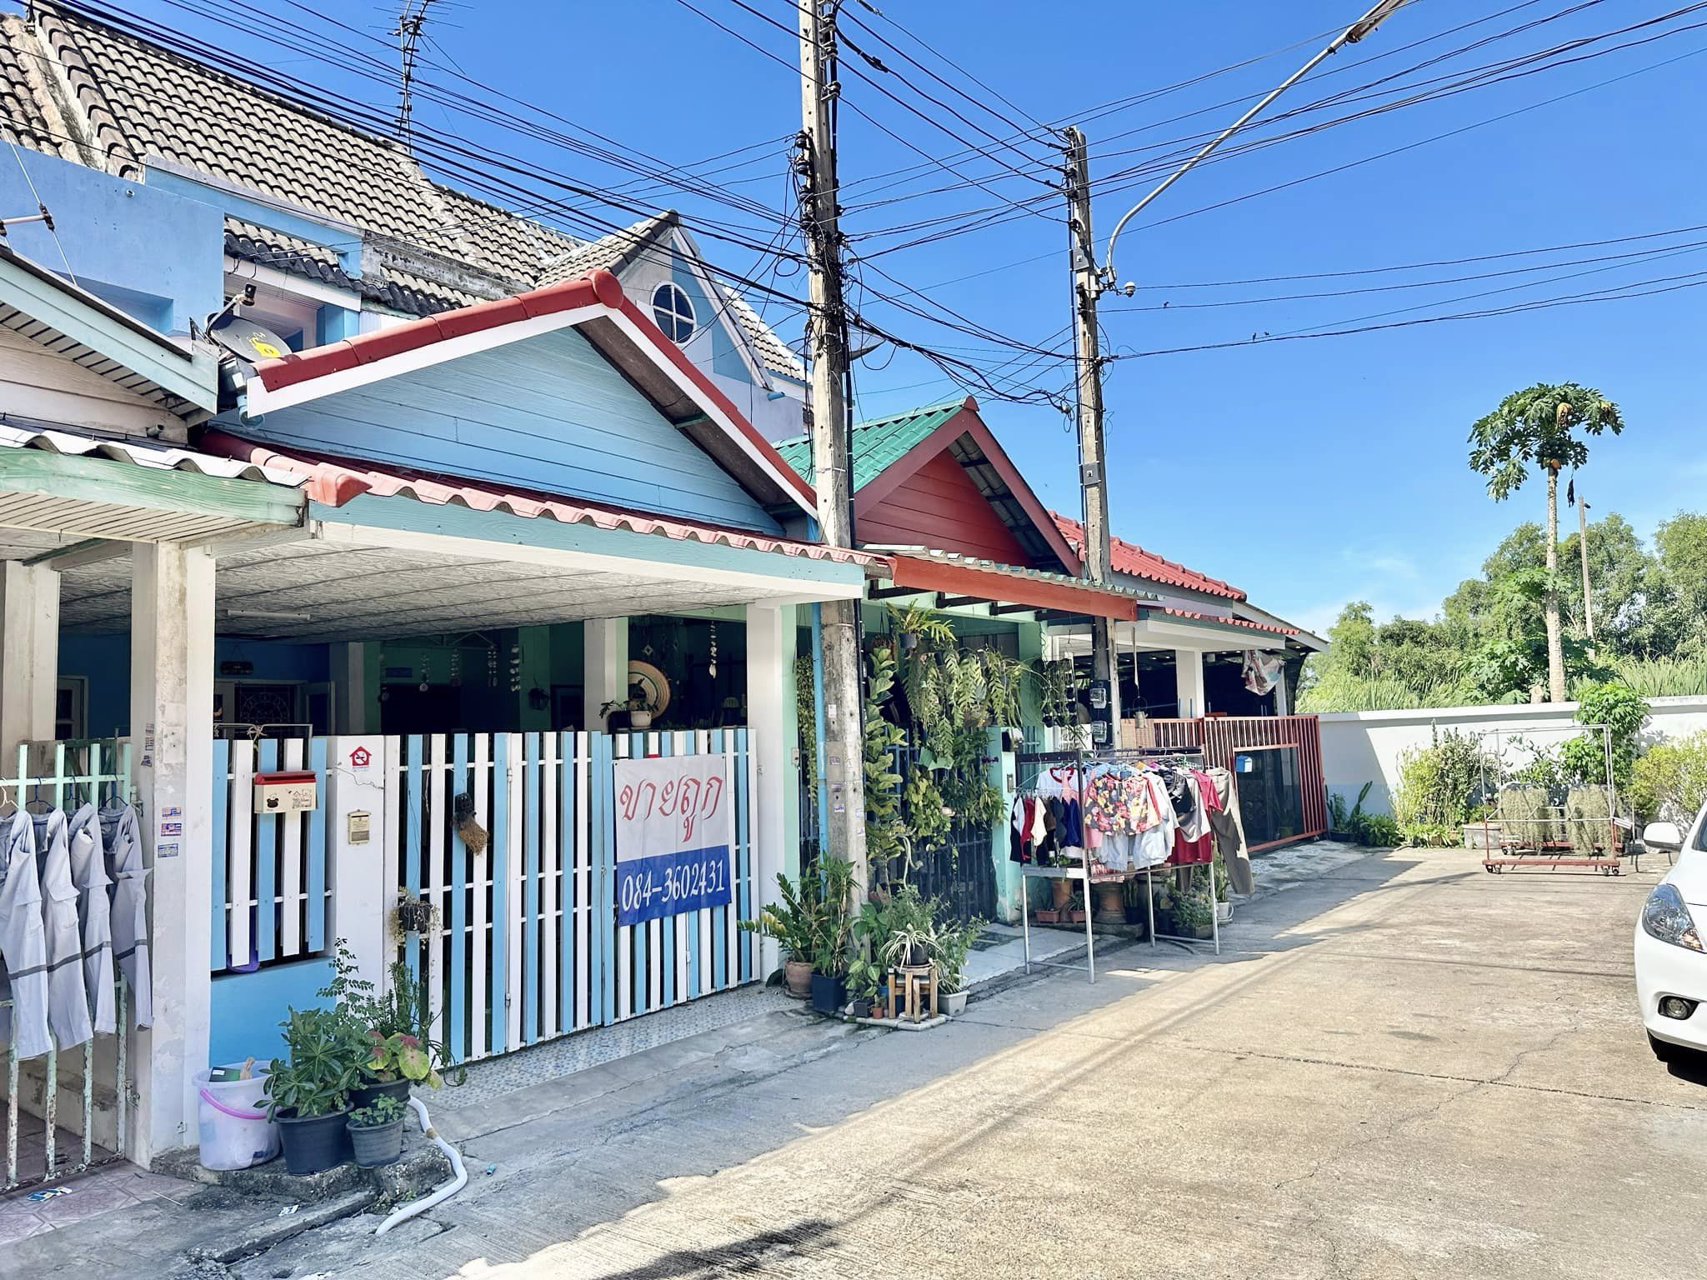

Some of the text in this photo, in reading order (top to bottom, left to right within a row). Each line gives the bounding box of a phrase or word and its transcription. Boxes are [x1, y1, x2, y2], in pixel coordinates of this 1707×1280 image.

[619, 775, 723, 842] ขายถูก
[622, 860, 725, 911] 084-3602431
